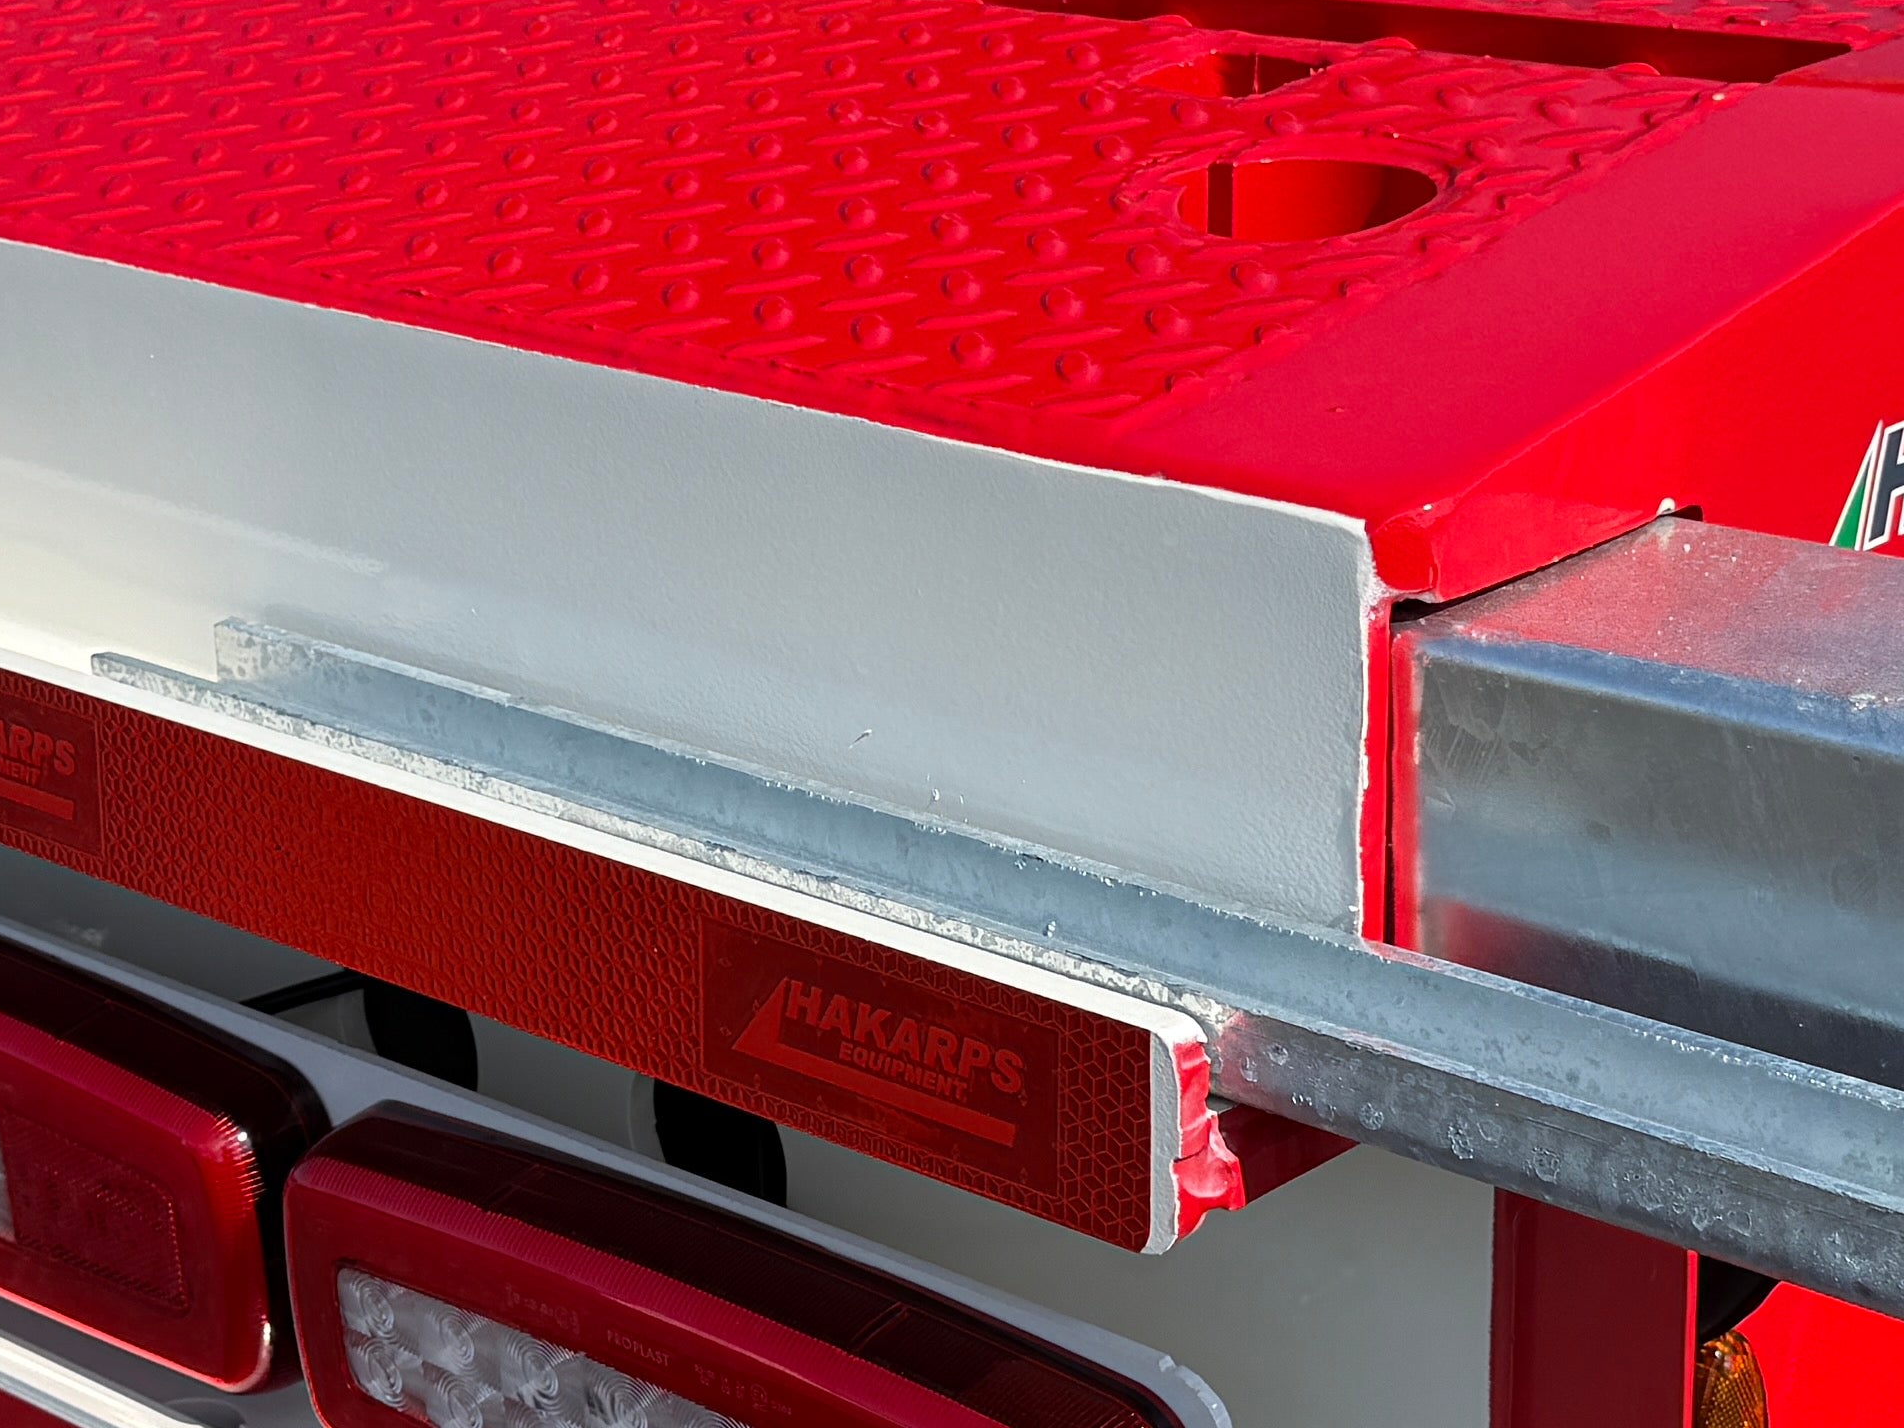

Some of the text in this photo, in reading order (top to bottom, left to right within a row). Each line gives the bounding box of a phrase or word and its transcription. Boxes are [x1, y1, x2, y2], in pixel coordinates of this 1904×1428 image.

[787, 980, 1024, 1095] HAKARPS
[839, 1038, 967, 1102] EQUIPMENT
[606, 1328, 671, 1368] PROPLAST
